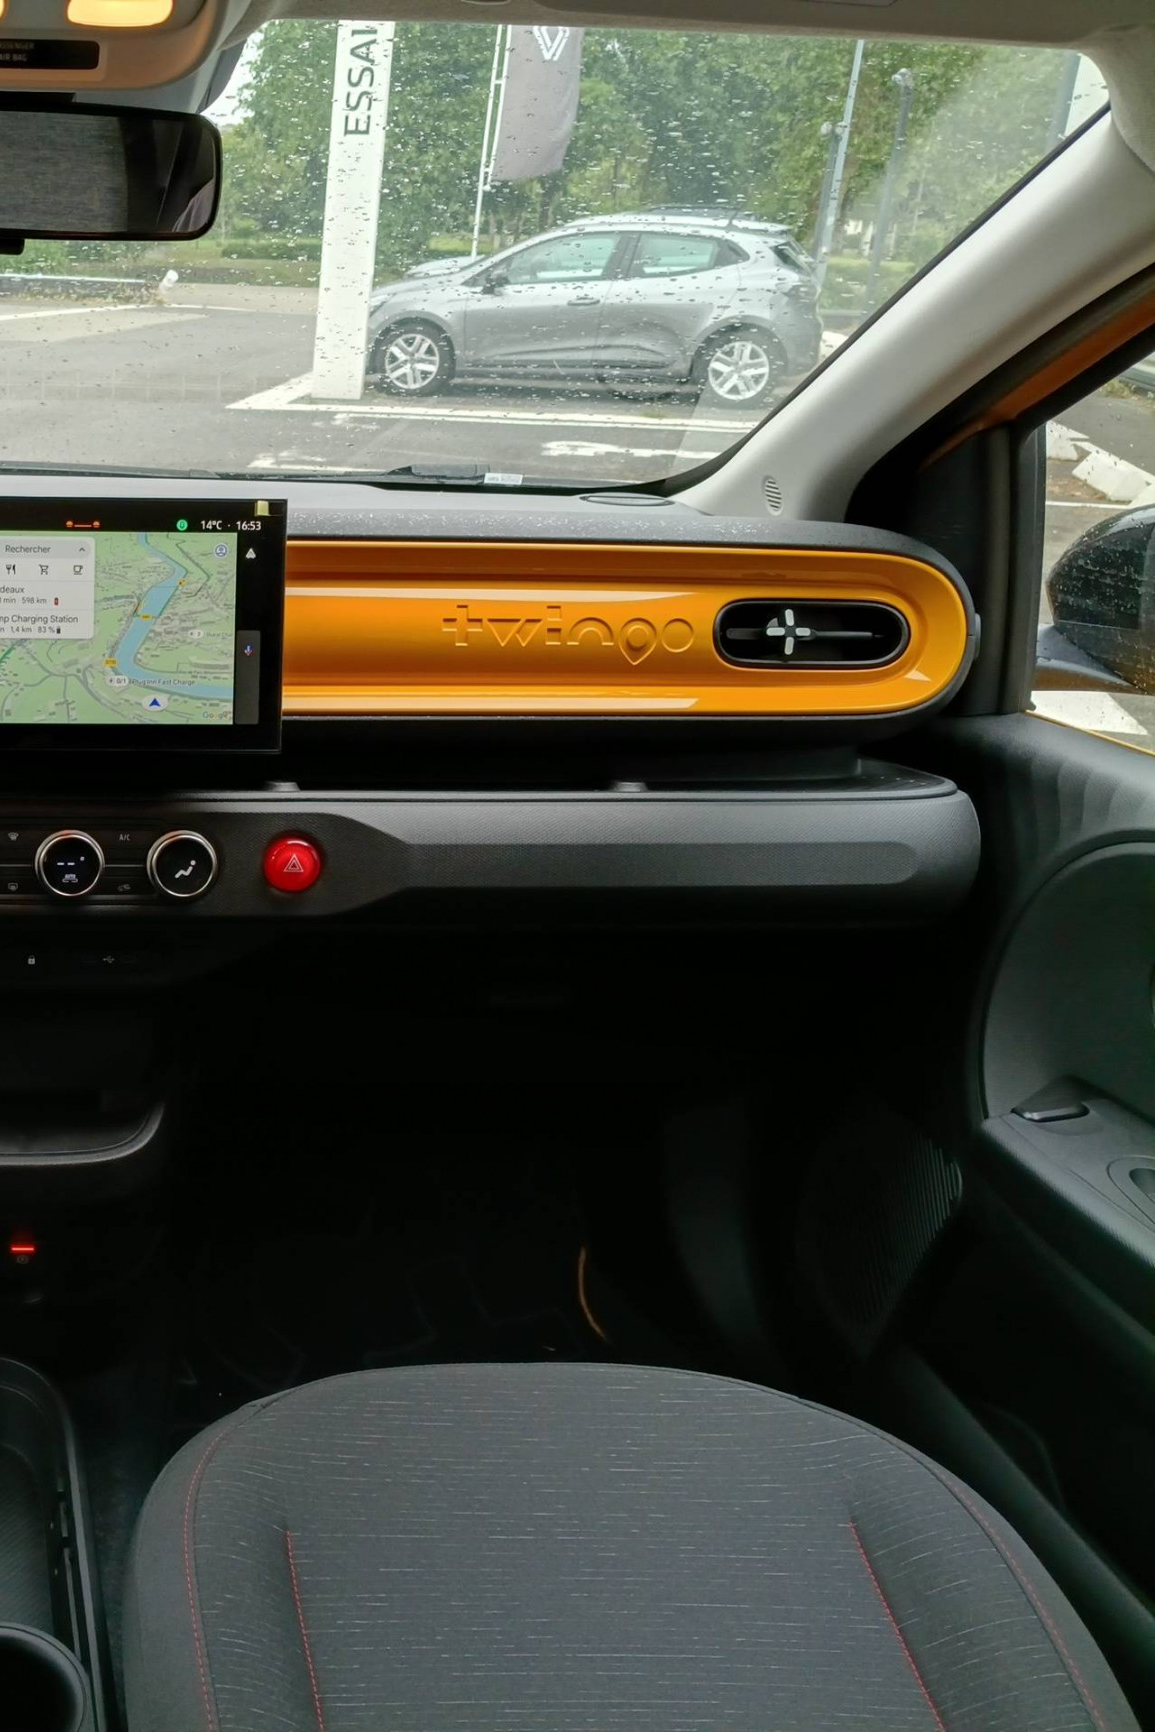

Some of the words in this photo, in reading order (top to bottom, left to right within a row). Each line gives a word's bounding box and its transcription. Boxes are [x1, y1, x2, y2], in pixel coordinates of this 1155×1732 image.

[343, 28, 378, 136] ESSAI
[236, 521, 262, 531] 16:53
[5, 544, 51, 554] Rechercher
[11, 615, 48, 625] Charging
[50, 615, 79, 624] Station
[442, 604, 695, 665] twingo
[119, 833, 131, 842] A/C
